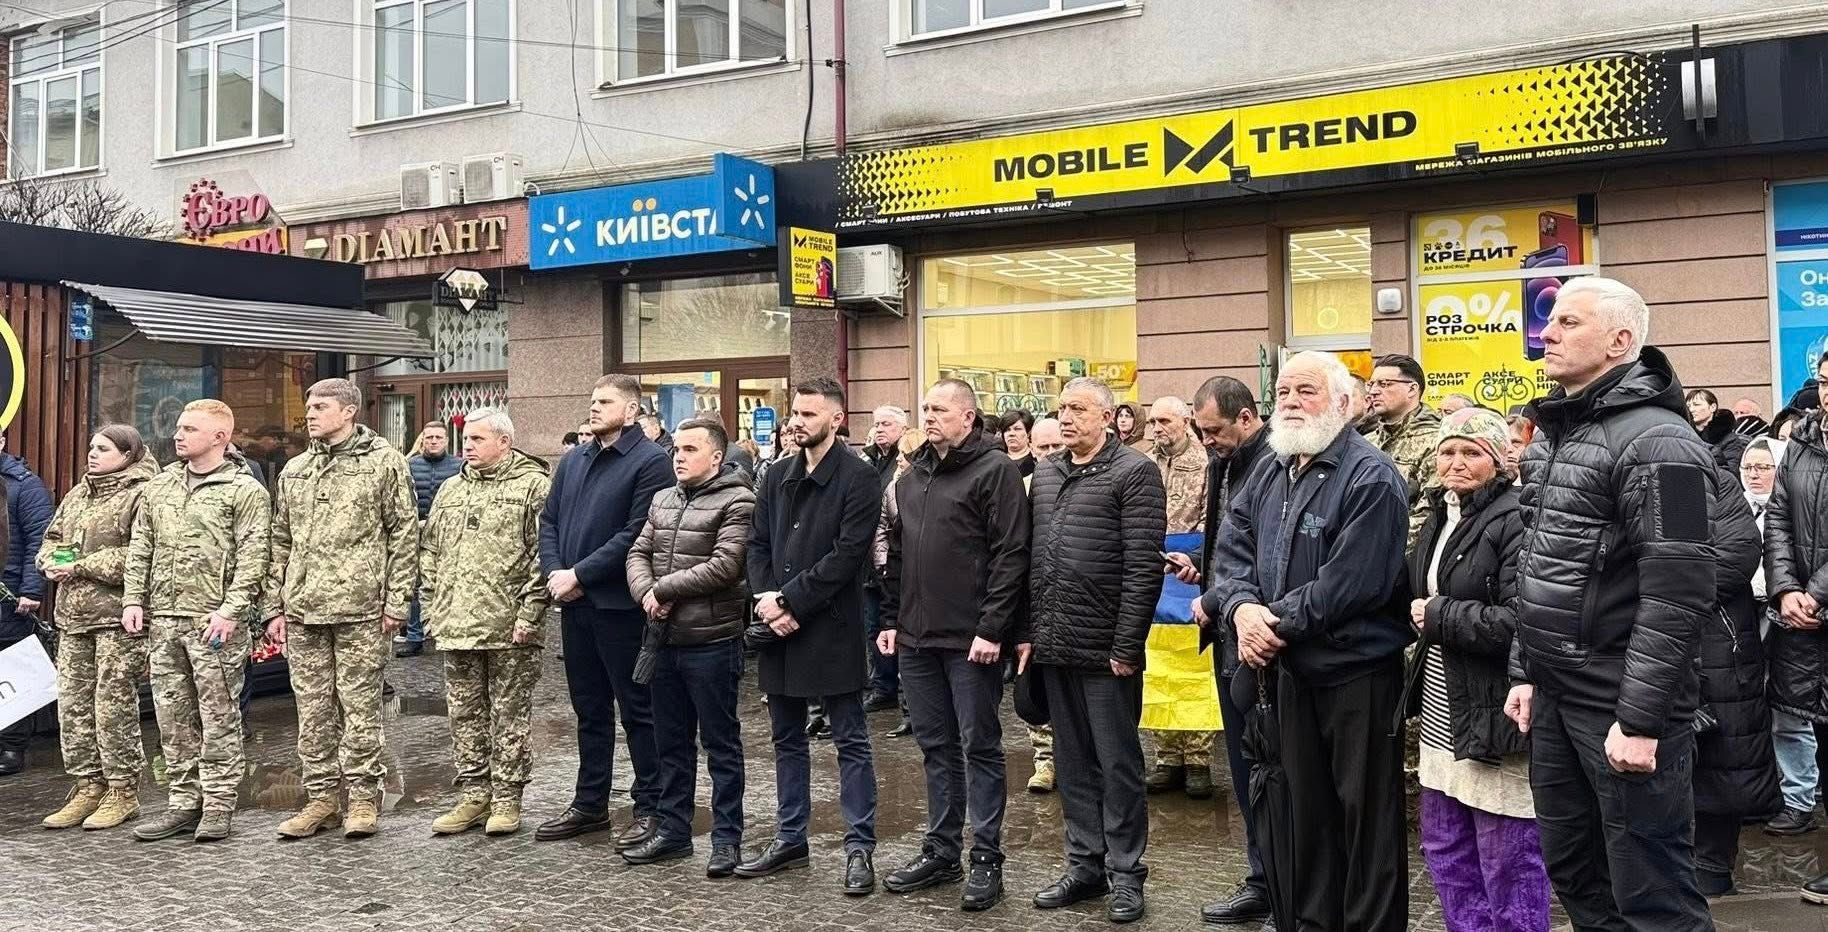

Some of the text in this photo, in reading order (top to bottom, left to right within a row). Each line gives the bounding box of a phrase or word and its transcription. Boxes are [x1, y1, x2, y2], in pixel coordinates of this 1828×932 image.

[994, 110, 1418, 183] MOBILE TREND
[1415, 160, 1464, 171] МЕРЕЖА
[1536, 143, 1615, 158] МОБІЛЬНОГО
[1618, 137, 1668, 149] ЗВ'ЯЗКУ
[895, 212, 941, 223] АКСЕСУАРИ
[949, 207, 991, 217] ПОБУТОВА
[993, 204, 1029, 213] ТЕХНІКА
[809, 242, 833, 252] TREND
[1423, 245, 1518, 264] КРЕДИТ
[1426, 315, 1462, 325] РОЗ
[1426, 323, 1517, 335] СТРОЧКА
[1427, 379, 1464, 387] ФОНИ
